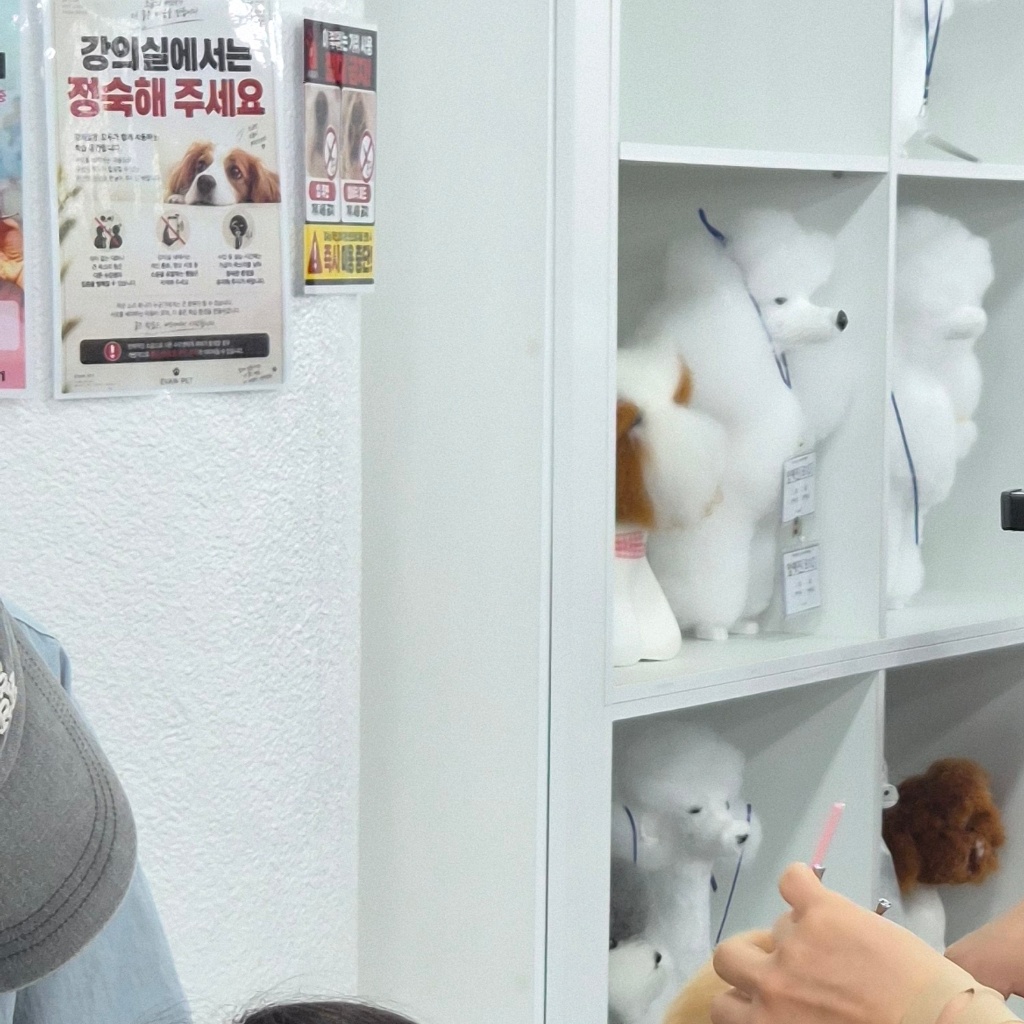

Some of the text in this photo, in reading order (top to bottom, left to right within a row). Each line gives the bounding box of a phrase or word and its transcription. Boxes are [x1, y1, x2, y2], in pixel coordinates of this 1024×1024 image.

[80, 35, 252, 72] 강의실에서는
[67, 76, 266, 118] 정숙해 주세요
